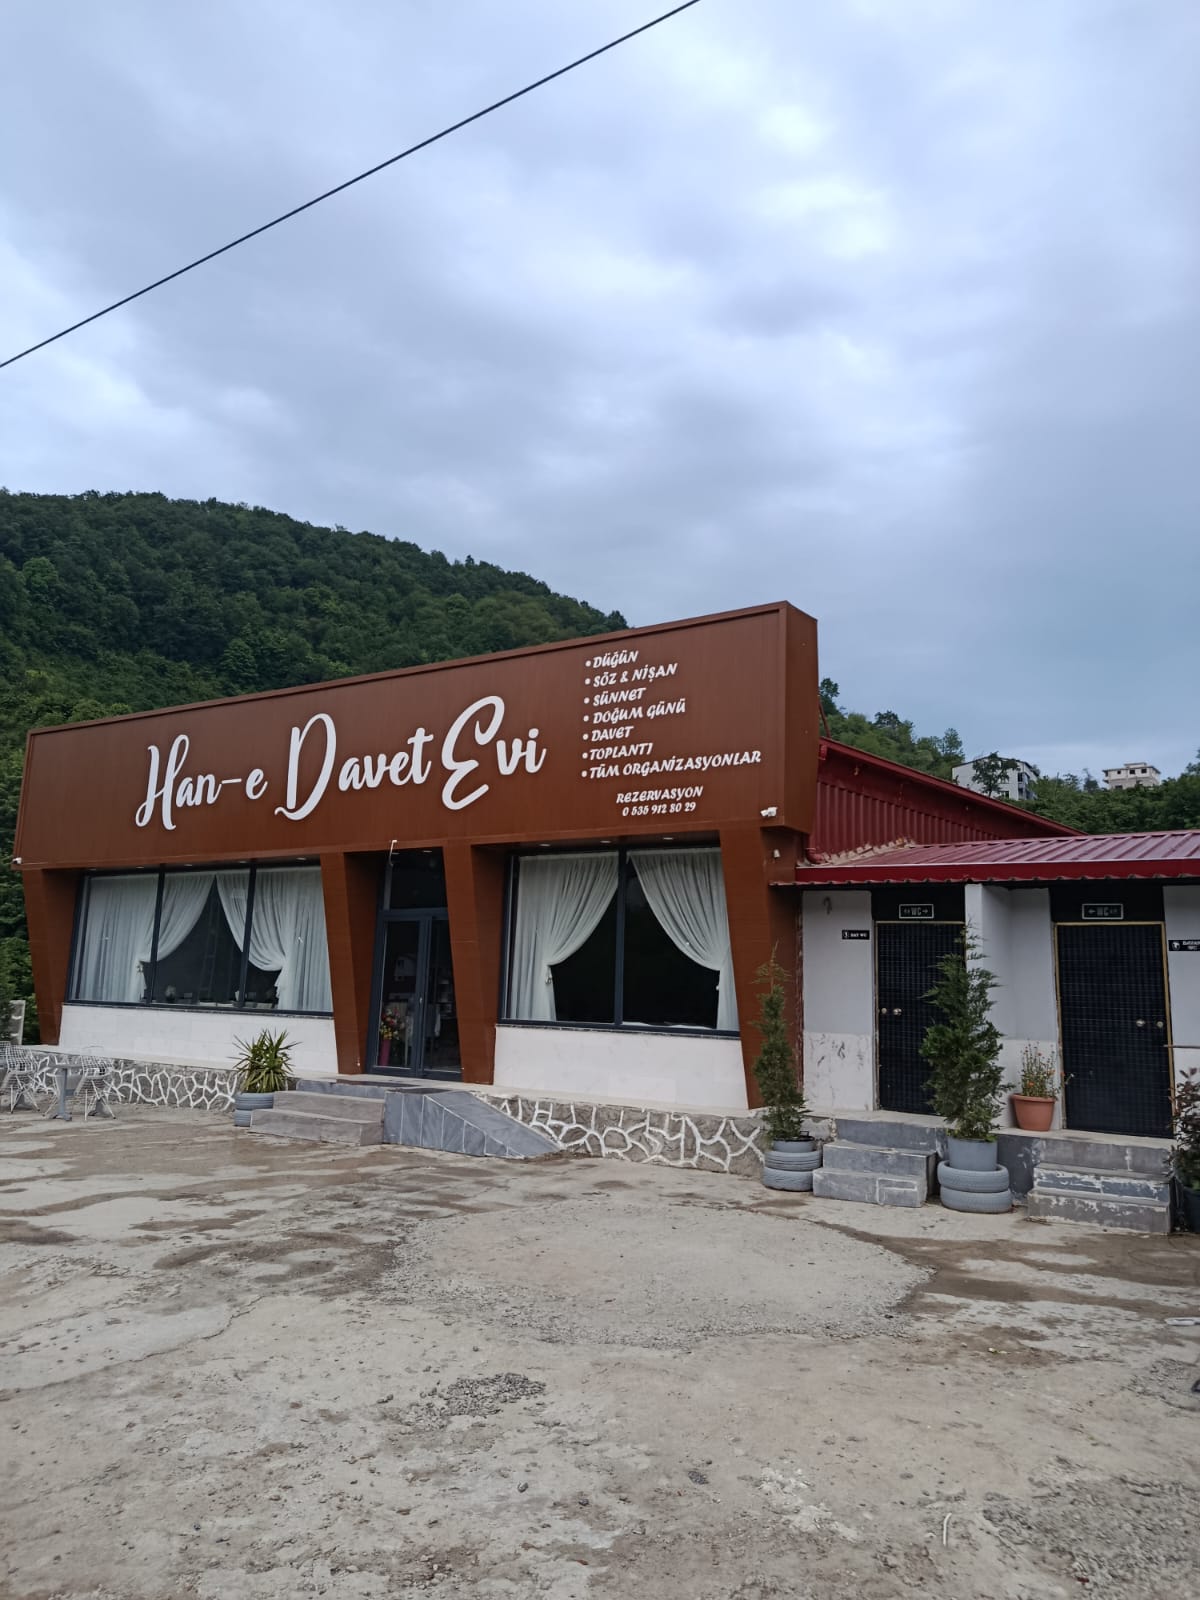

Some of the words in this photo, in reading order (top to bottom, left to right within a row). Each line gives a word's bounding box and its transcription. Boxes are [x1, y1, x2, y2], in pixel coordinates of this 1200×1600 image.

[592, 650, 639, 669] DÜĞÜN
[592, 671, 617, 688] SÖZ
[619, 671, 629, 684] &
[631, 663, 678, 683] NİŞAN
[592, 687, 647, 707] SÜNNET
[592, 706, 644, 725] DOĞUM
[646, 698, 686, 720] GÜNÜ
[591, 726, 634, 741] DAVET
[589, 742, 654, 761] TOPLANTI
[135, 734, 268, 831] Han-e
[274, 712, 434, 821] Davet
[441, 695, 547, 811] Evi
[589, 763, 620, 779] TÜM
[622, 750, 762, 777] ORGANİZASYONLAR
[615, 786, 704, 804] REZERVASYON
[622, 806, 630, 817] 0
[651, 803, 668, 815] 912
[669, 803, 683, 814] 80
[684, 801, 697, 812] 29
[911, 906, 922, 916] WC
